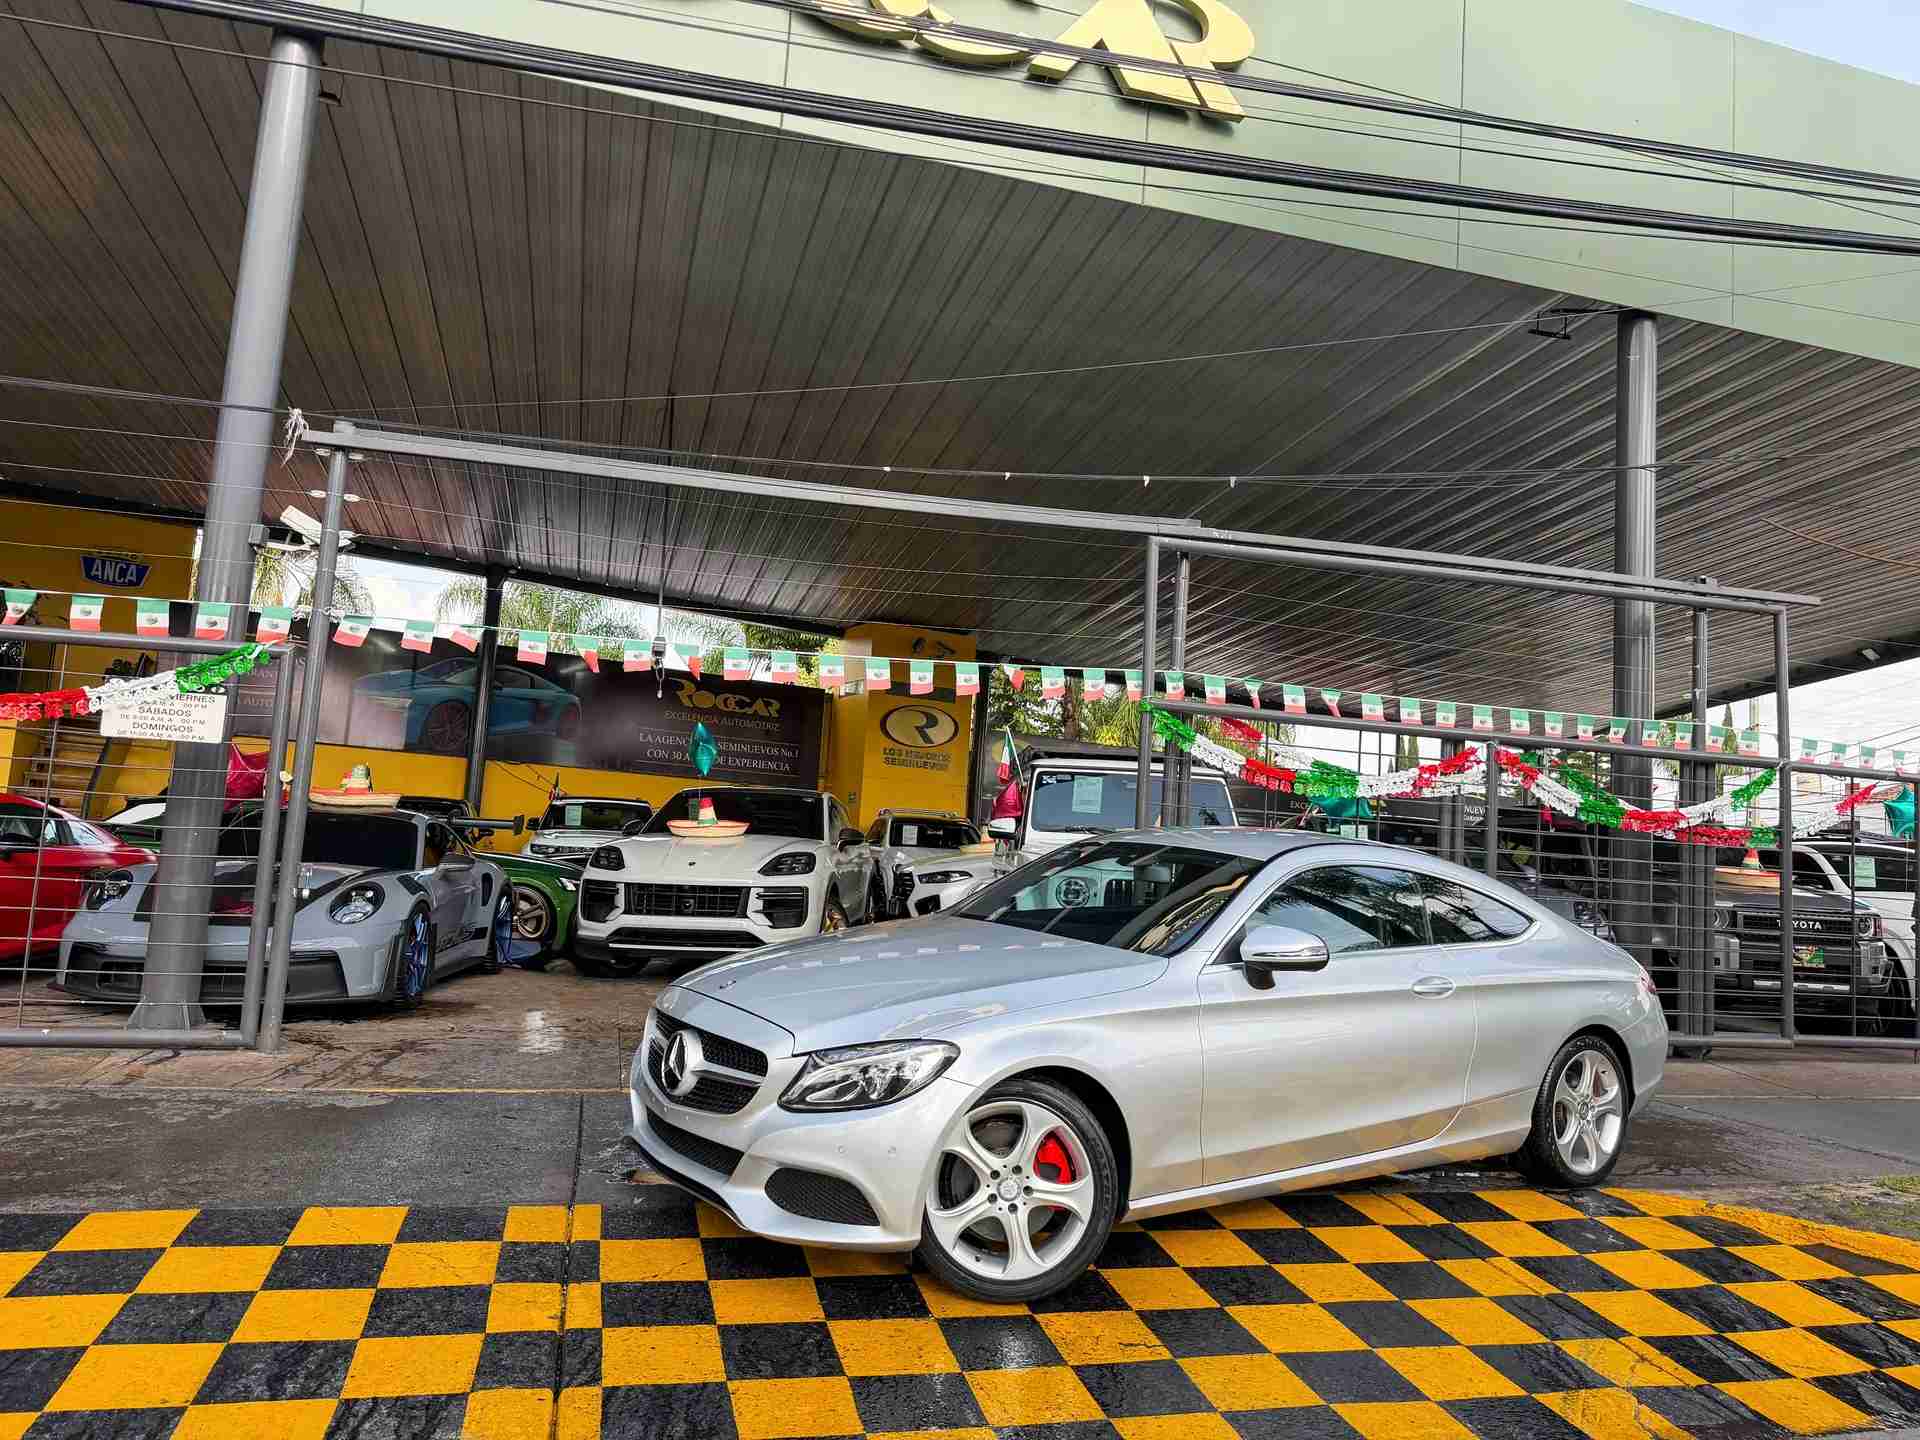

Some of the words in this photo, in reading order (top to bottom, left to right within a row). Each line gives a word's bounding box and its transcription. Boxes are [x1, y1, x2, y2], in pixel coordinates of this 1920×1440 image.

[132, 721, 193, 733] DOMINGOS
[647, 748, 669, 761] CON
[729, 756, 791, 771] EXPERIENCIA
[1776, 919, 1822, 930] TYOTA
